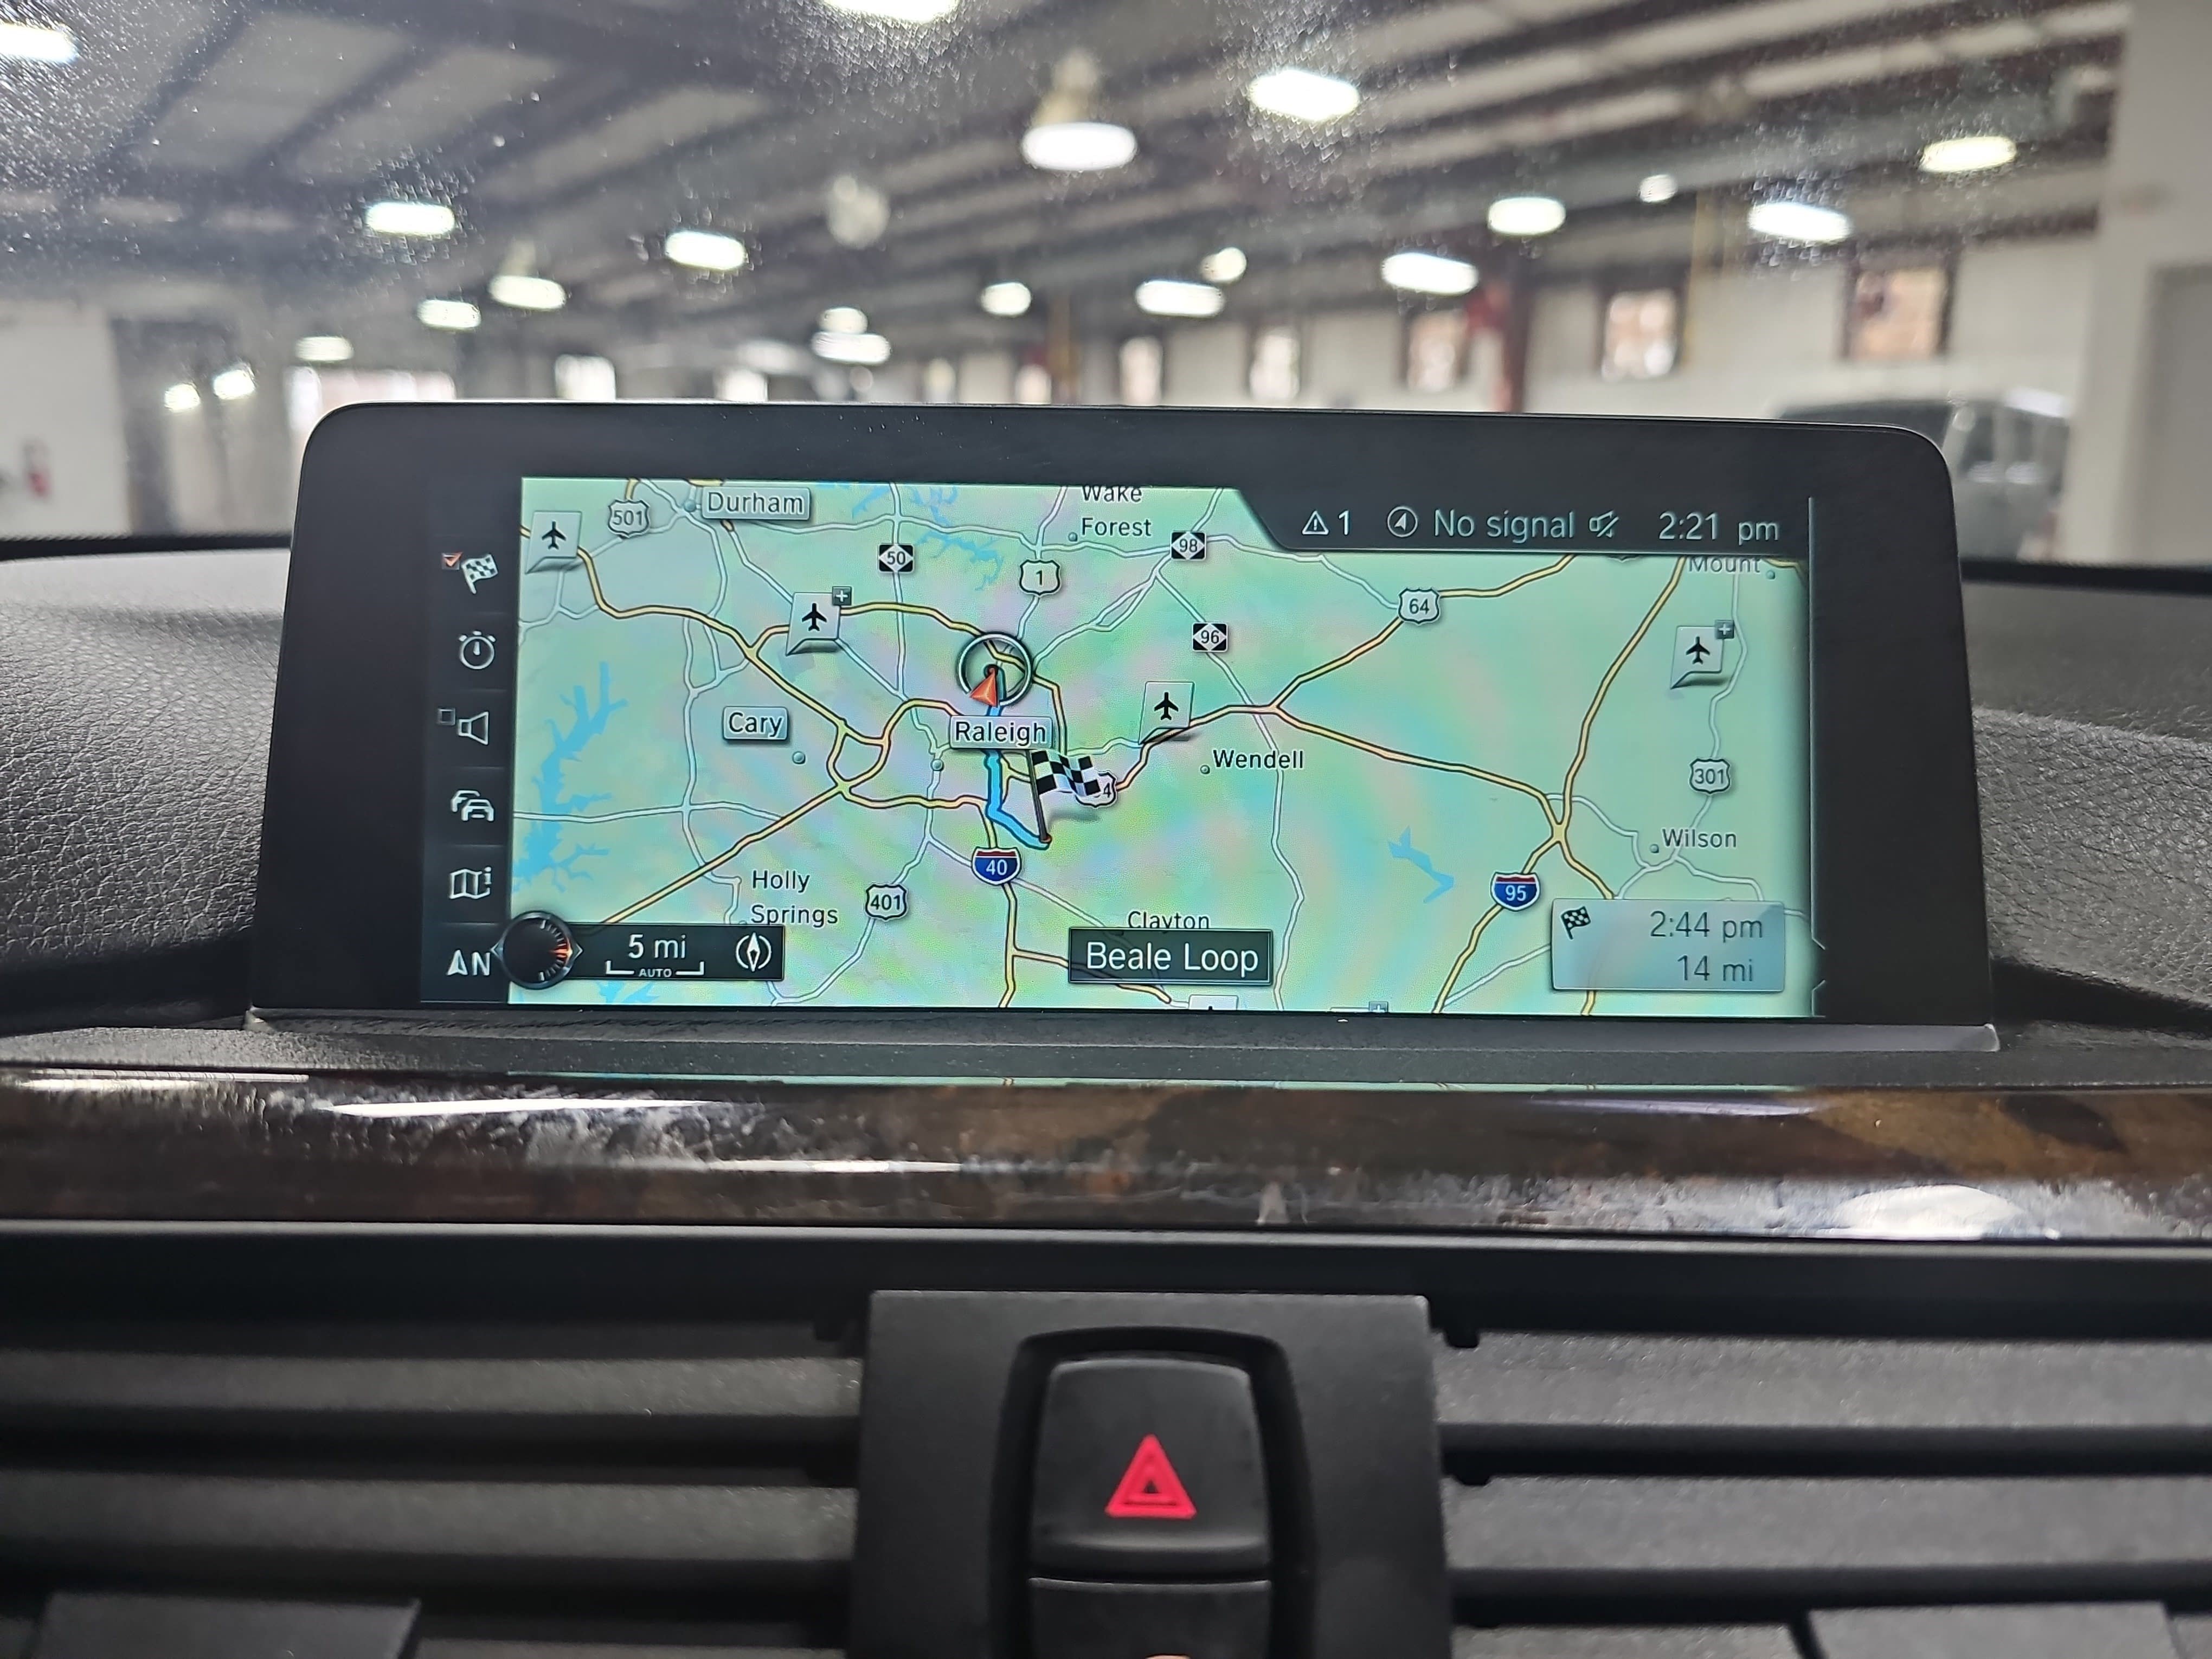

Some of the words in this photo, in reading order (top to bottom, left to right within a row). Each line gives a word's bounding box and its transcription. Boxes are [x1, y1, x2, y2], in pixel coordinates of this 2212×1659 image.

[707, 492, 805, 514] Durham
[1082, 486, 1142, 503] Wake
[612, 510, 644, 526] 501
[1082, 517, 1152, 537] Forest
[1338, 511, 1350, 535] 1
[1434, 512, 1475, 537] No
[1487, 510, 1574, 543] signal
[1659, 512, 1718, 540] 2:21
[1738, 520, 1779, 545] pm
[1179, 538, 1198, 553] 98
[887, 551, 906, 565] 50
[1689, 556, 1761, 574] Mount
[1036, 570, 1044, 585] 1
[1409, 599, 1430, 615] 64
[1200, 629, 1220, 644] 96
[728, 712, 783, 736] Cary
[955, 722, 1047, 745] Raleigh
[1213, 750, 1304, 769] Wendell
[1694, 768, 1726, 785] 301
[1662, 828, 1737, 848] Wilson
[986, 859, 1007, 875] 40
[753, 870, 810, 893] Holly
[870, 894, 902, 910] 401
[1505, 885, 1527, 901] 95
[751, 905, 838, 928] Springs
[1128, 911, 1210, 929] Clayton
[1650, 911, 1709, 938] 2:44
[1722, 917, 1763, 943] pm
[628, 934, 643, 958] 5
[655, 934, 686, 959] mi
[1087, 942, 1171, 970] Beale
[1185, 943, 1259, 978] Loop
[1679, 955, 1709, 981] 14
[1722, 956, 1753, 982] mi
[639, 968, 672, 978] AUTO
